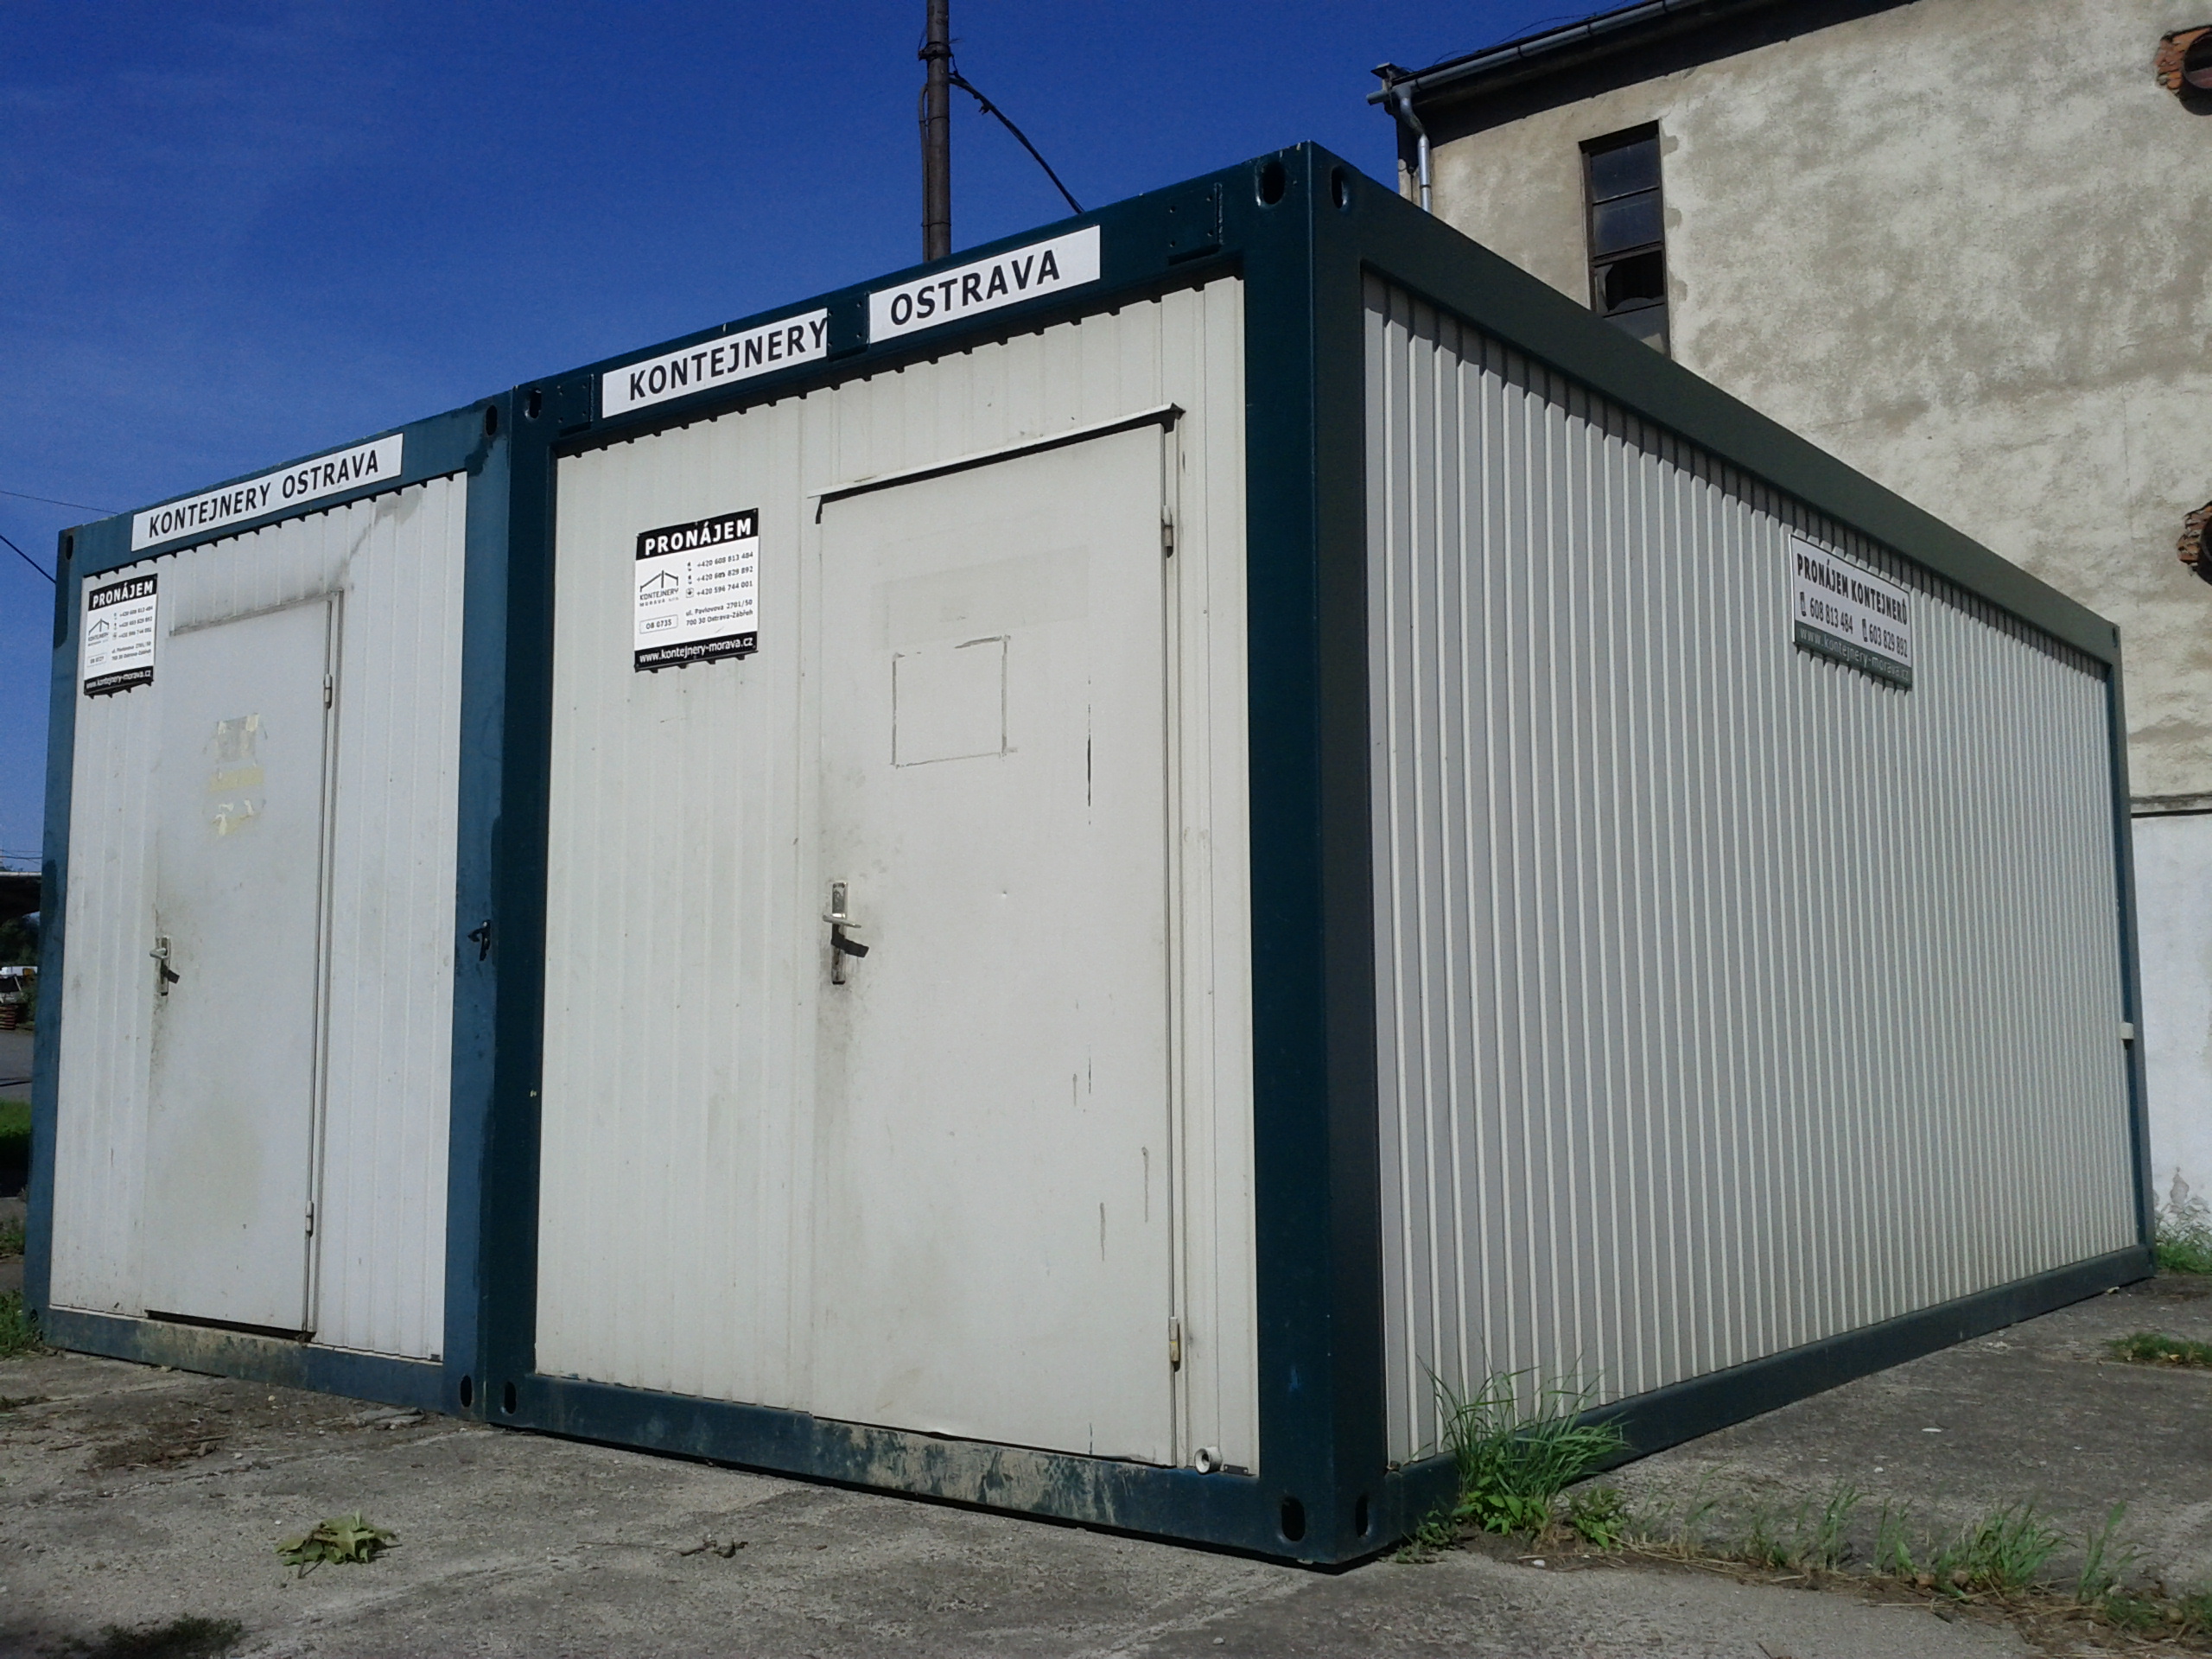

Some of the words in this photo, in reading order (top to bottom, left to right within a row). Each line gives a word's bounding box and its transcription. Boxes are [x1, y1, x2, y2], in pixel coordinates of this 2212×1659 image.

[629, 316, 827, 401] KONTEJNERY
[890, 249, 1060, 326] OSTRAVA
[149, 482, 270, 538] KONTEJNERY
[282, 449, 378, 499] OSTRAVA
[645, 518, 751, 556] PRONÁJEM
[696, 573, 713, 582] +420
[741, 565, 753, 574] 892
[715, 556, 726, 565] 608
[728, 554, 740, 563] 813
[92, 580, 154, 608] PRONÁJEM
[639, 588, 679, 601] KONTEJNERY
[696, 588, 713, 596] +420
[728, 582, 740, 591] 744
[741, 580, 753, 588] 001
[1796, 553, 1849, 598] PRONÁJEM
[1851, 578, 1908, 626] KONTEJNERŮ
[1809, 597, 1824, 622] 608
[1825, 606, 1839, 628] 813
[1840, 612, 1853, 634] 484
[639, 636, 753, 663] www.kontejnery-morava.cz
[1869, 623, 1882, 646] 603
[1883, 629, 1895, 652] 829
[1897, 635, 1908, 658] 892
